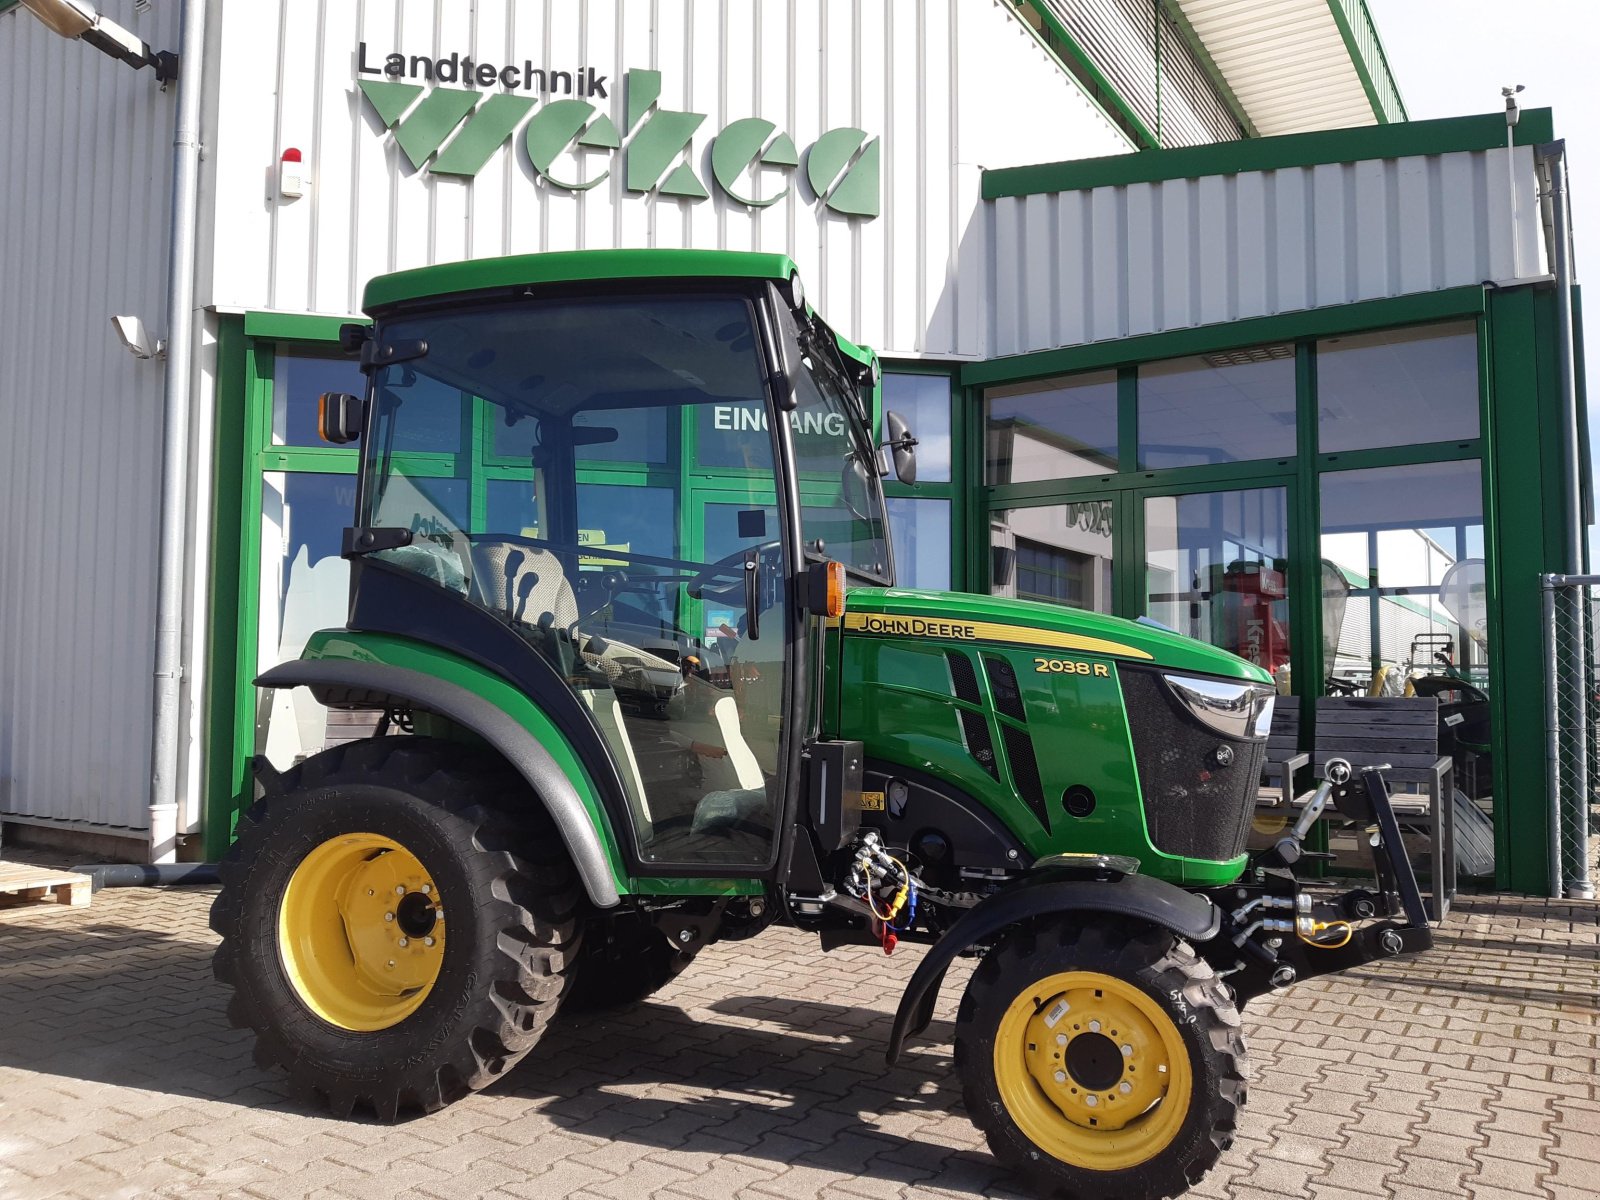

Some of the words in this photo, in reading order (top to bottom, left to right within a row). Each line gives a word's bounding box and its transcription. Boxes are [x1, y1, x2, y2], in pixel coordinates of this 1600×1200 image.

[358, 42, 608, 98] Landtechnik
[859, 616, 909, 633] JOHN
[912, 619, 976, 638] DEERE
[1247, 620, 1265, 666] Kres
[1034, 658, 1091, 676] 2038
[1093, 663, 1110, 678] R
